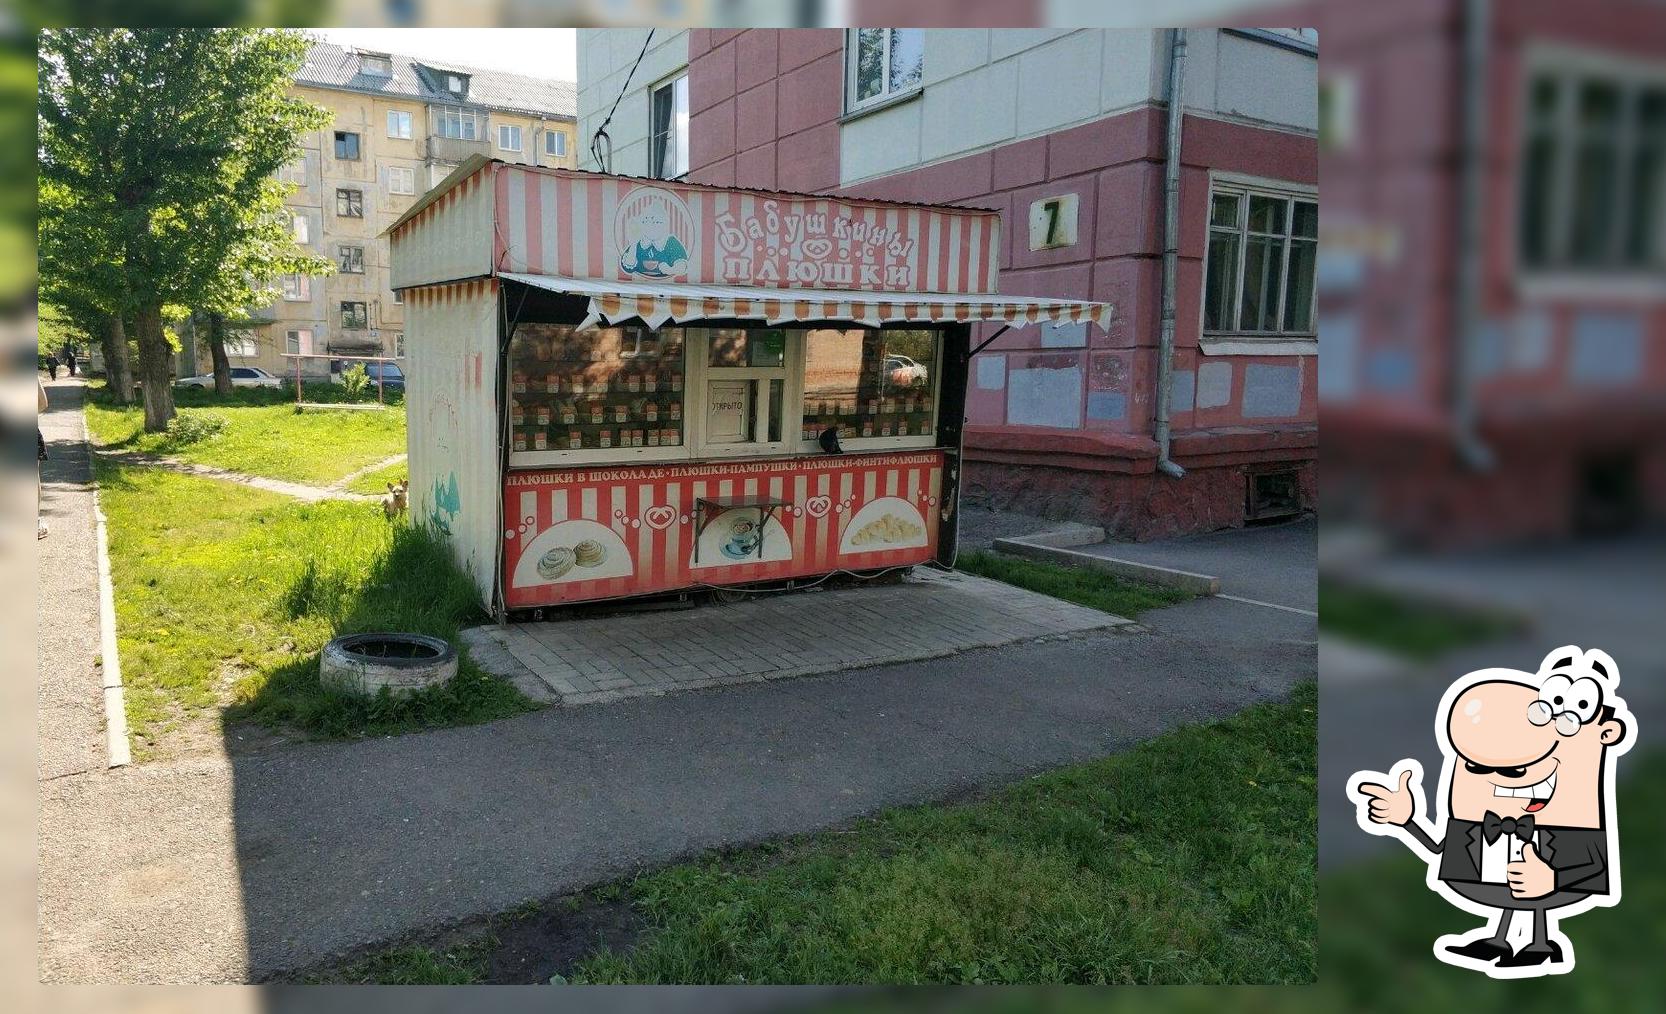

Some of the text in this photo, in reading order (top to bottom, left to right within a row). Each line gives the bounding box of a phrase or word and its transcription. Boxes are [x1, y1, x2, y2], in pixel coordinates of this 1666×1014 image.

[714, 200, 914, 257] Бабушкины
[1044, 201, 1060, 244] 7
[723, 256, 910, 286] ПЛЮШКИ
[507, 472, 574, 486] ПЛЮШКИ
[577, 472, 586, 482] В
[589, 468, 665, 482] ШОКОЛАДЕ
